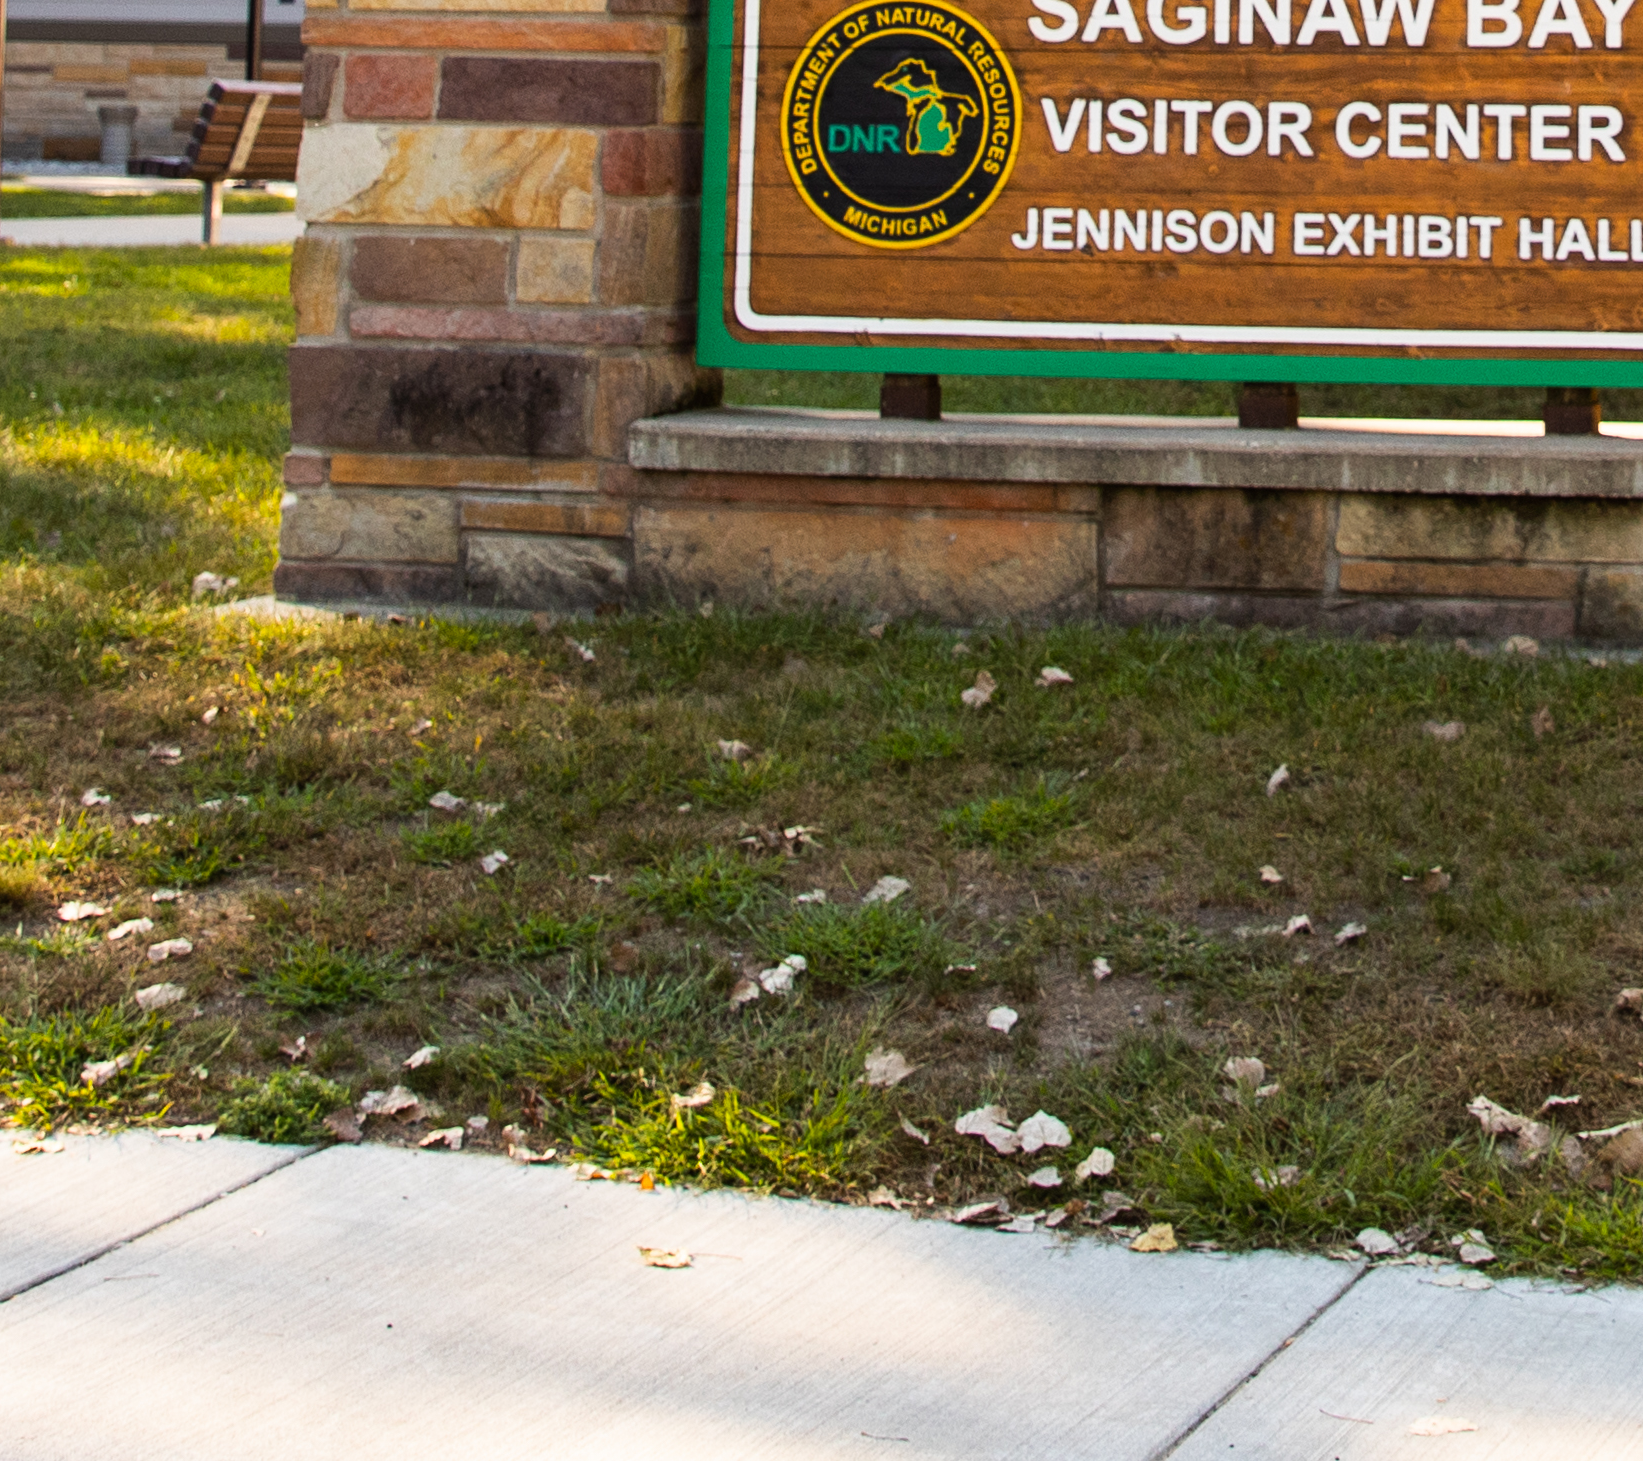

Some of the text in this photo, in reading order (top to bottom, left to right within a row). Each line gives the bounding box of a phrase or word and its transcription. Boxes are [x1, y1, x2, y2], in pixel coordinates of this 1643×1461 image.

[792, 6, 1010, 176] DEPARTMENT OF NATURAL RESOURCES
[827, 123, 901, 153] DNR
[1039, 97, 1627, 163] VISITOR CENTER
[843, 205, 948, 236] MICHIGAN
[1010, 206, 1276, 255] JENNISON
[1292, 211, 1504, 260] EXHIBIT
